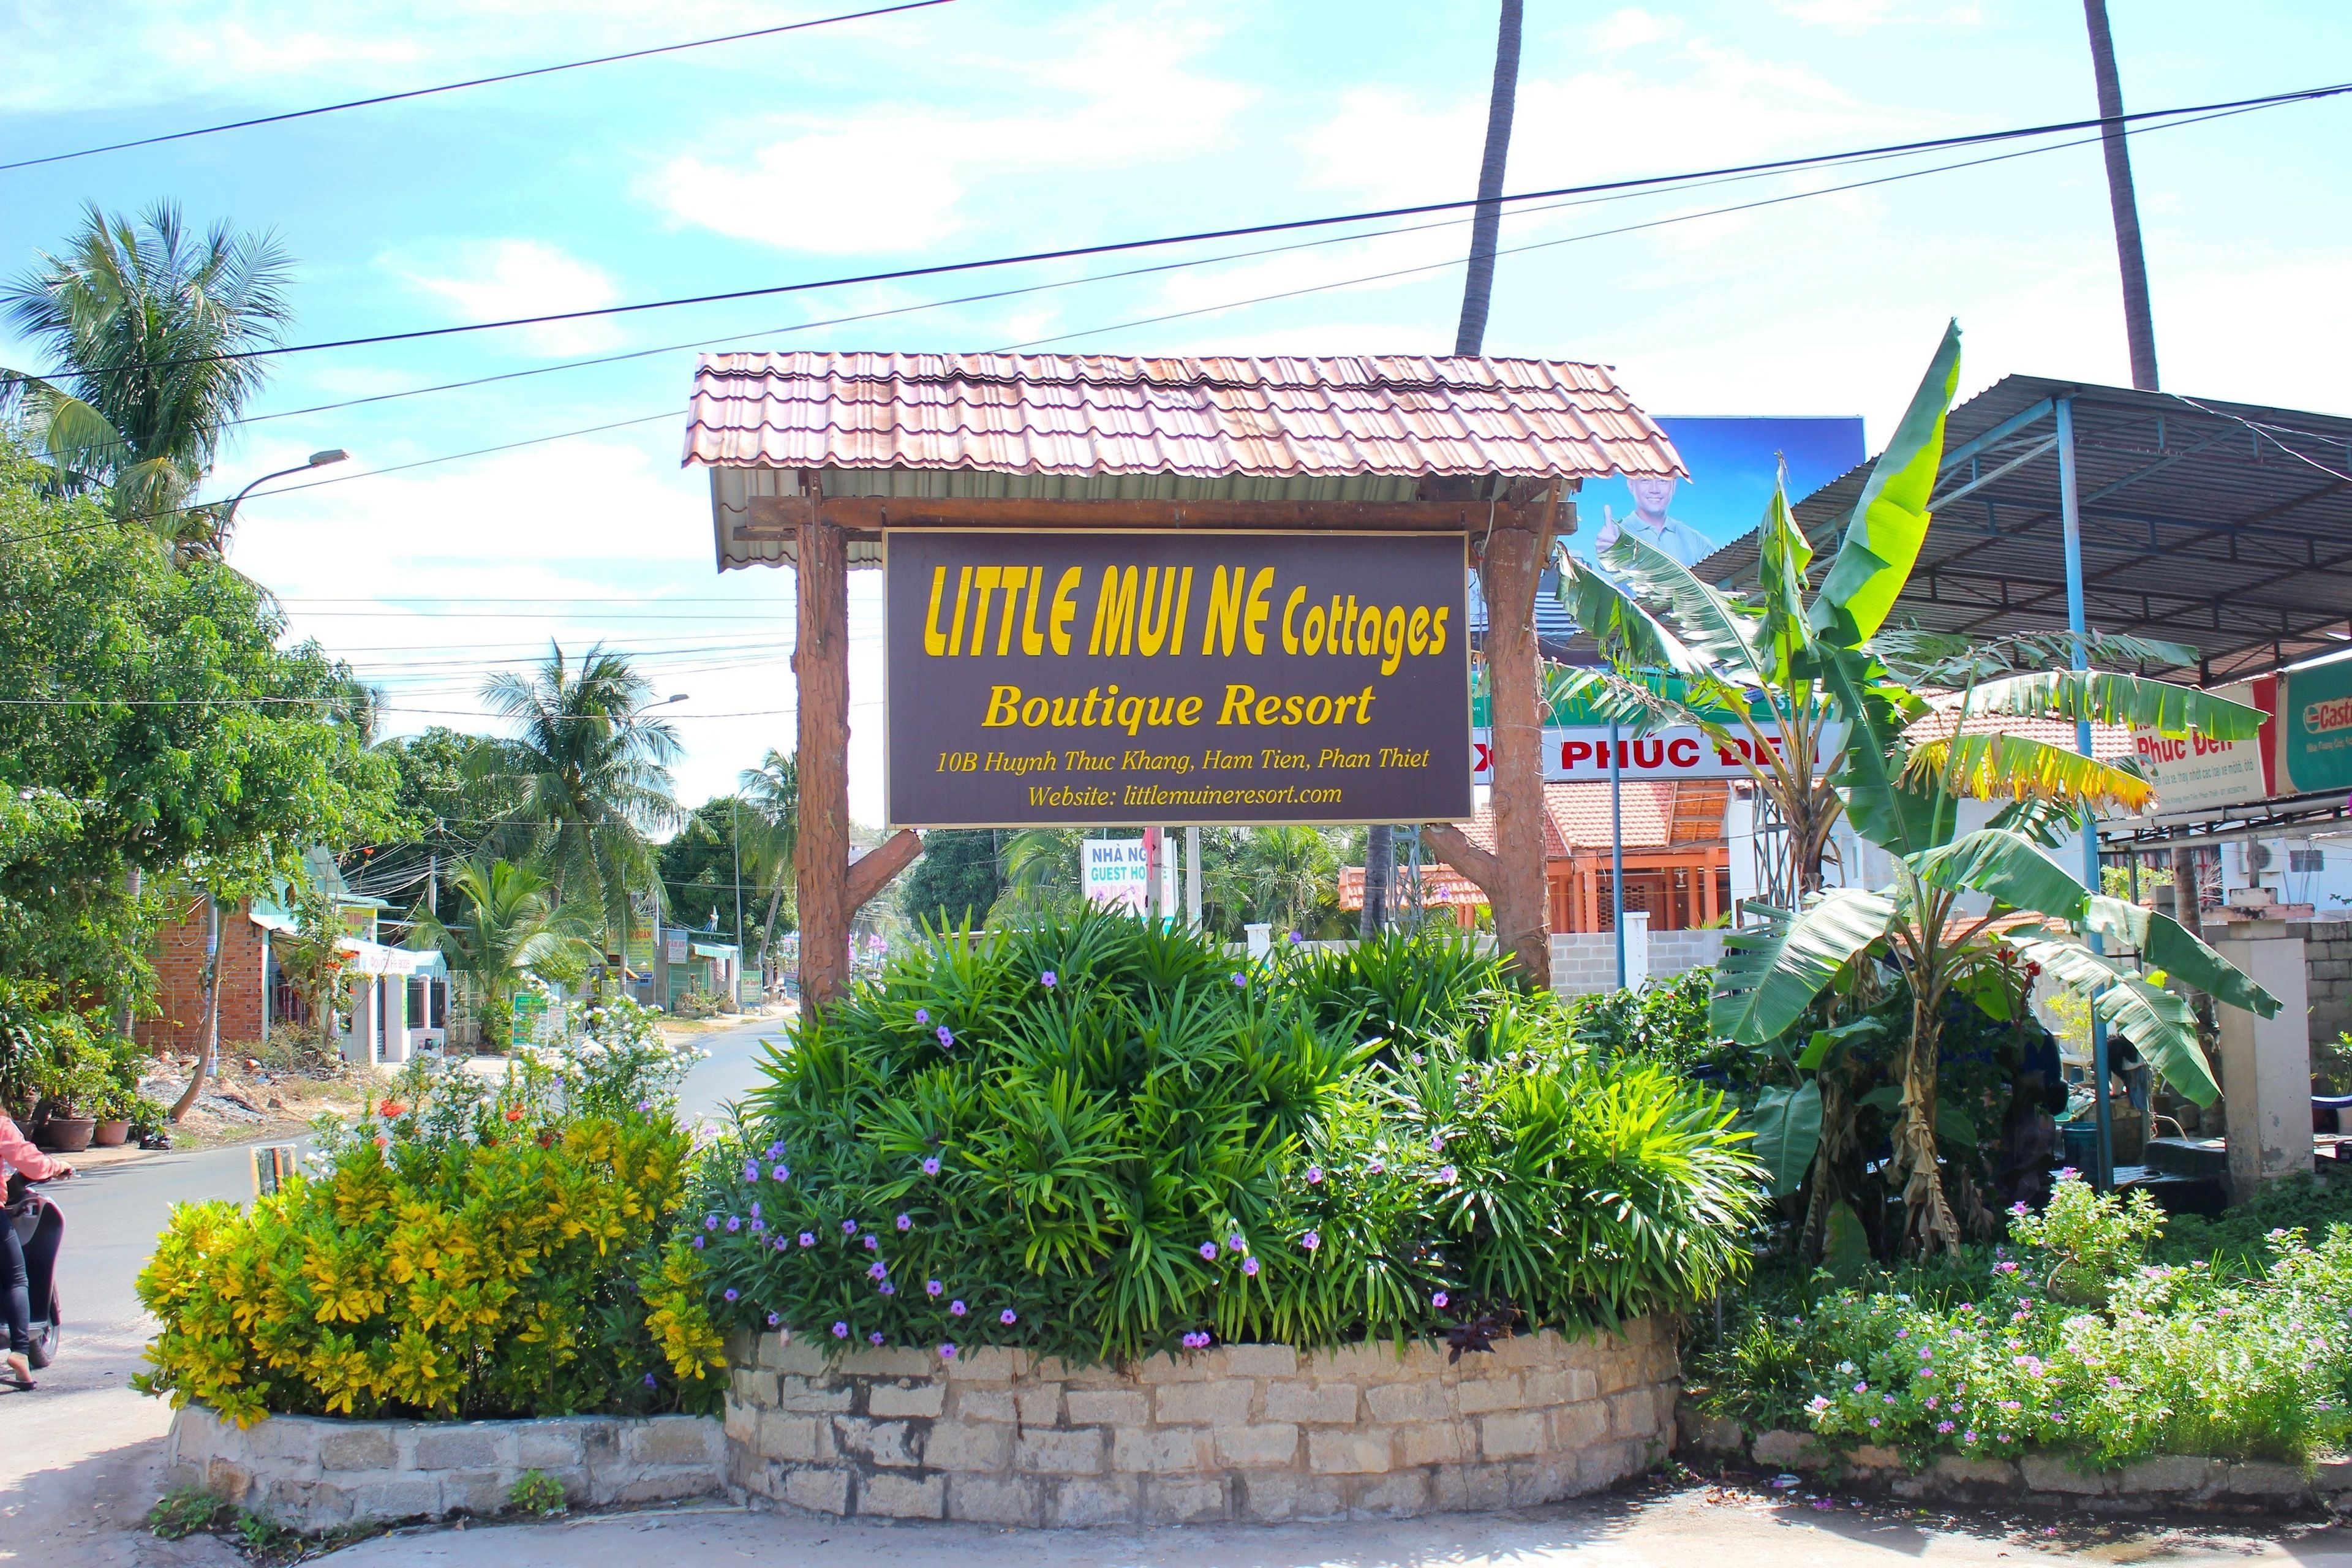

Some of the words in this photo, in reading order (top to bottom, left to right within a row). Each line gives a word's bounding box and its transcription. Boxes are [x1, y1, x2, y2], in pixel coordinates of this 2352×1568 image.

[924, 565, 1083, 657] LITTLE
[1088, 564, 1194, 658] MUI
[1202, 564, 1275, 657] NE
[1281, 586, 1450, 677] Cottages
[981, 684, 1204, 737] Boutique
[1215, 684, 1377, 726] Resort
[2320, 701, 2352, 729] Cast
[936, 752, 979, 772] 10B
[983, 751, 1057, 777] Huynh
[1065, 749, 1116, 771] Thuc
[1120, 749, 1195, 775] Khang,
[1201, 749, 1254, 770] Ham
[1261, 748, 1311, 772] Tien,
[1317, 748, 1371, 769] Phan
[1378, 747, 1431, 769] Thiet
[1561, 731, 1700, 769] PHÚC
[1029, 785, 1117, 807] Website:
[1122, 784, 1343, 806] littlemuineresort.com
[1092, 843, 1123, 862] NHÀ
[1091, 866, 1127, 881] GUEST
[1131, 865, 1167, 880] HOE
